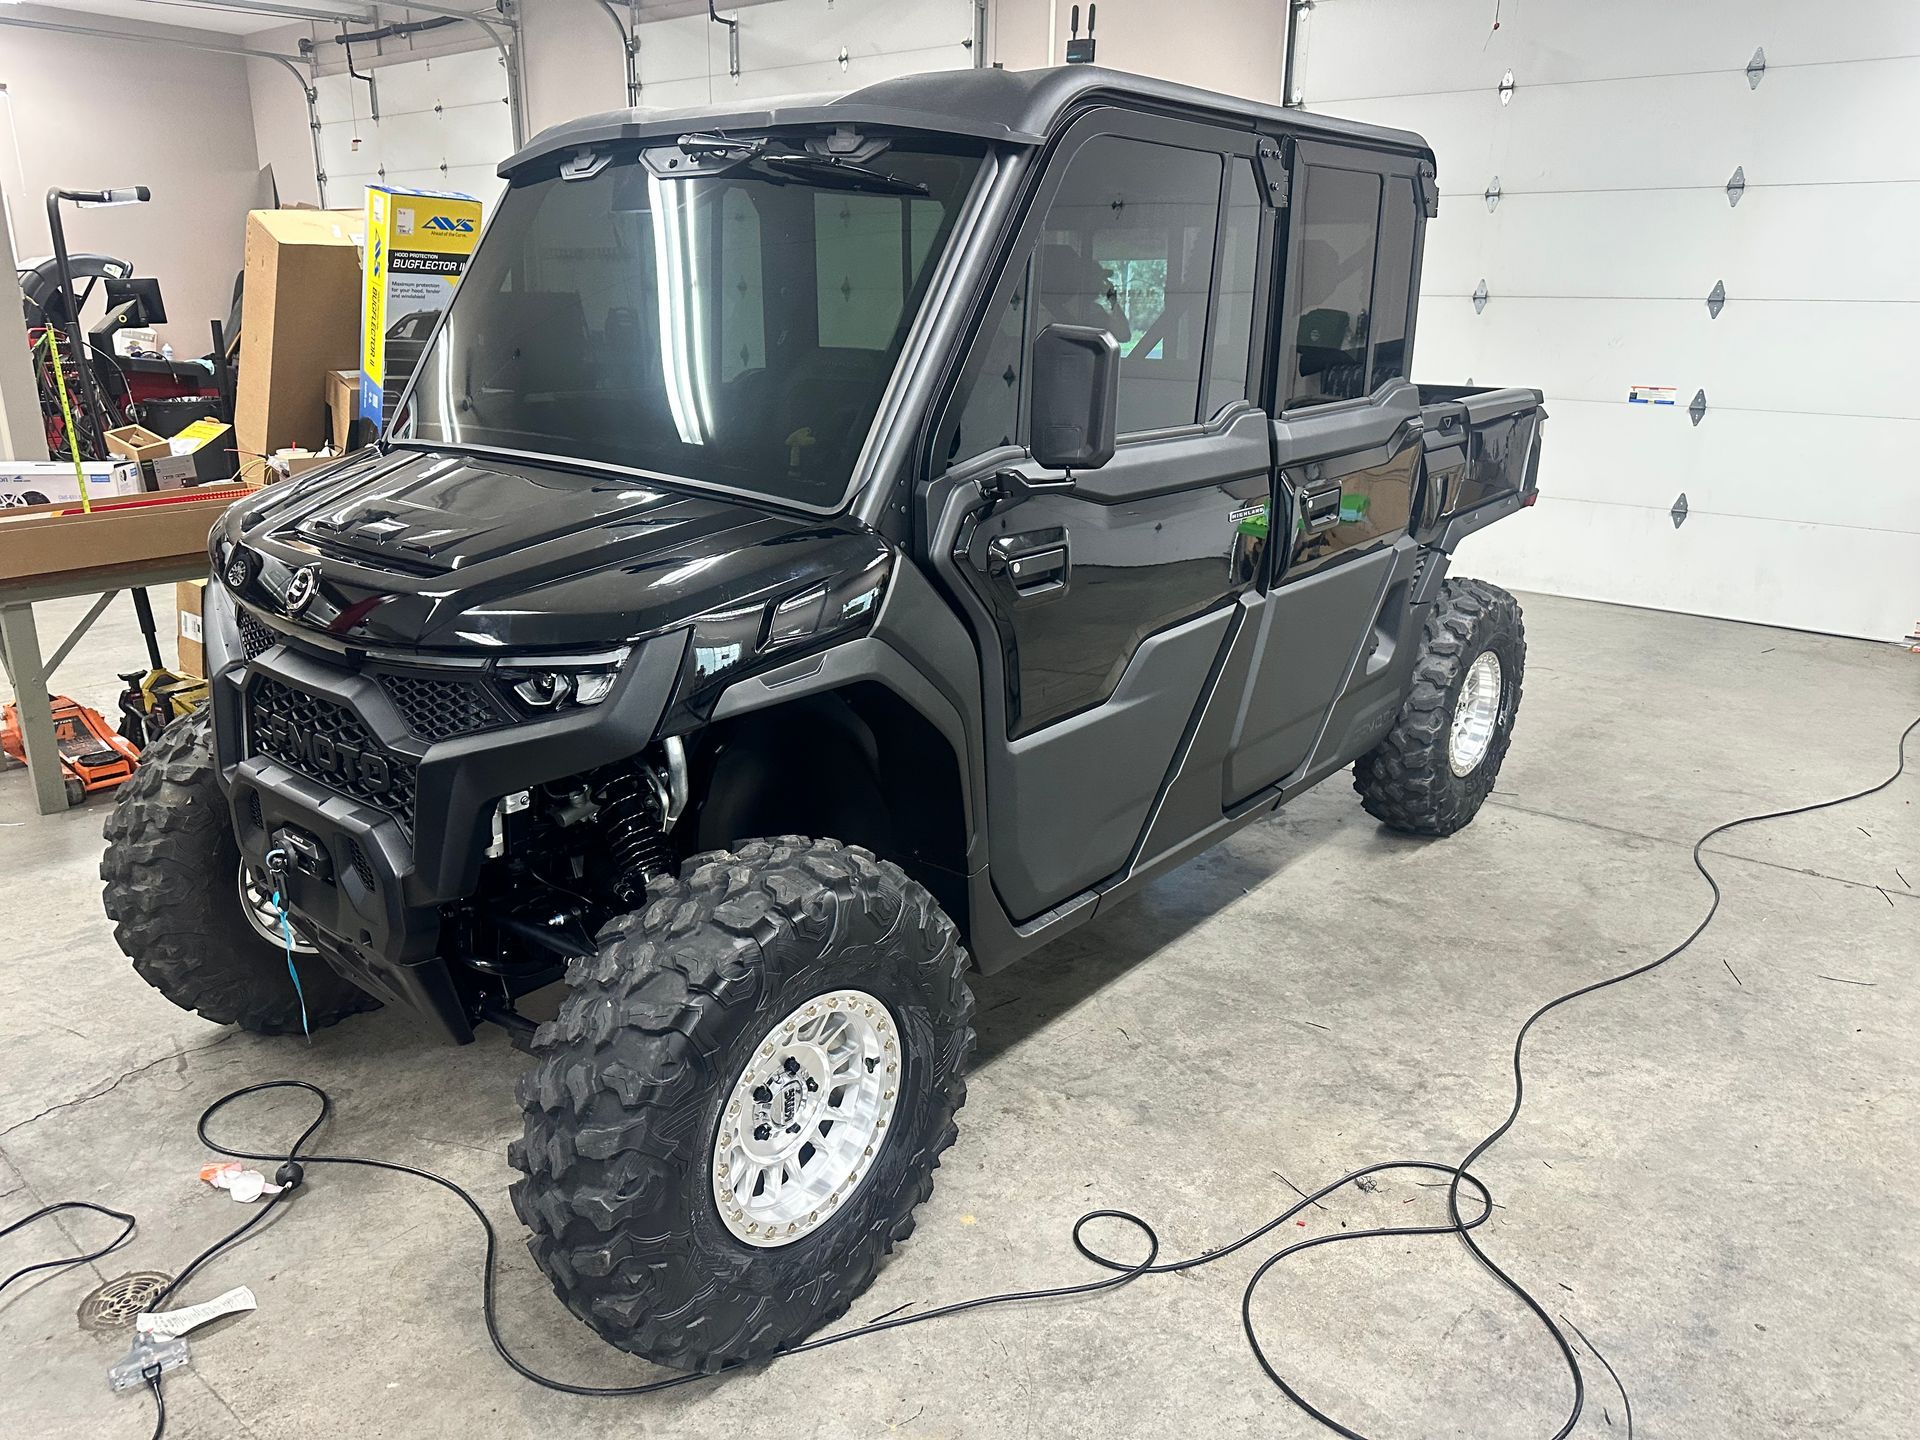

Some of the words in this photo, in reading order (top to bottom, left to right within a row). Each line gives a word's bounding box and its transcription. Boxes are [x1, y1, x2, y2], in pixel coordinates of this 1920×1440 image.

[421, 216, 475, 232] AVS
[392, 259, 458, 271] BUGFLECTOR
[370, 286, 378, 357] BUGFLECTOR
[255, 704, 391, 793] CFMOTO
